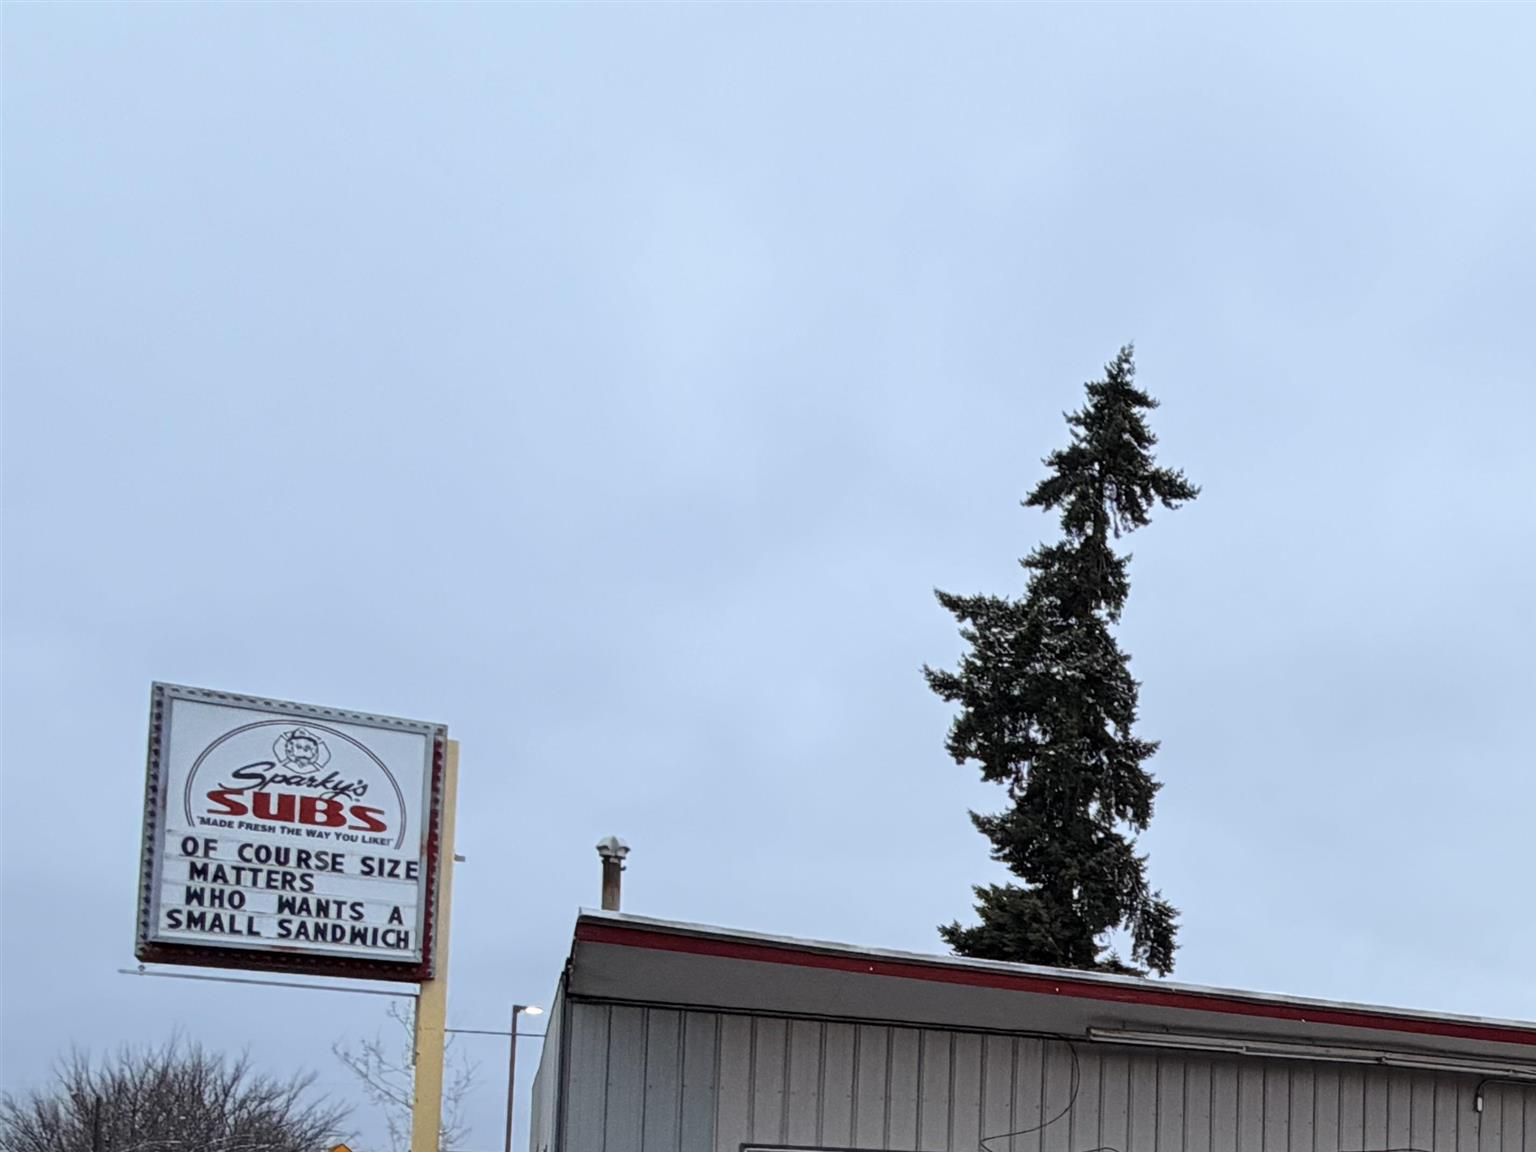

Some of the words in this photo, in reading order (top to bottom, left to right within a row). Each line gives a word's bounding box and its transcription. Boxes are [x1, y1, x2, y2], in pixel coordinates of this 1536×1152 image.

[218, 761, 369, 801] Sparky's
[206, 788, 388, 833] SUBS
[237, 821, 277, 834] FRESH
[280, 825, 303, 837] THE
[305, 828, 331, 840] WAY
[333, 832, 359, 843] YOU
[181, 836, 219, 858] OF
[237, 842, 346, 874] COURSE
[359, 856, 419, 881] SIZE
[189, 861, 315, 893] MATTERS
[185, 885, 247, 910] WHO
[277, 894, 365, 921] WANTS
[387, 905, 404, 926] A
[166, 908, 262, 938] SMALL
[276, 918, 410, 950] SANDWICH
